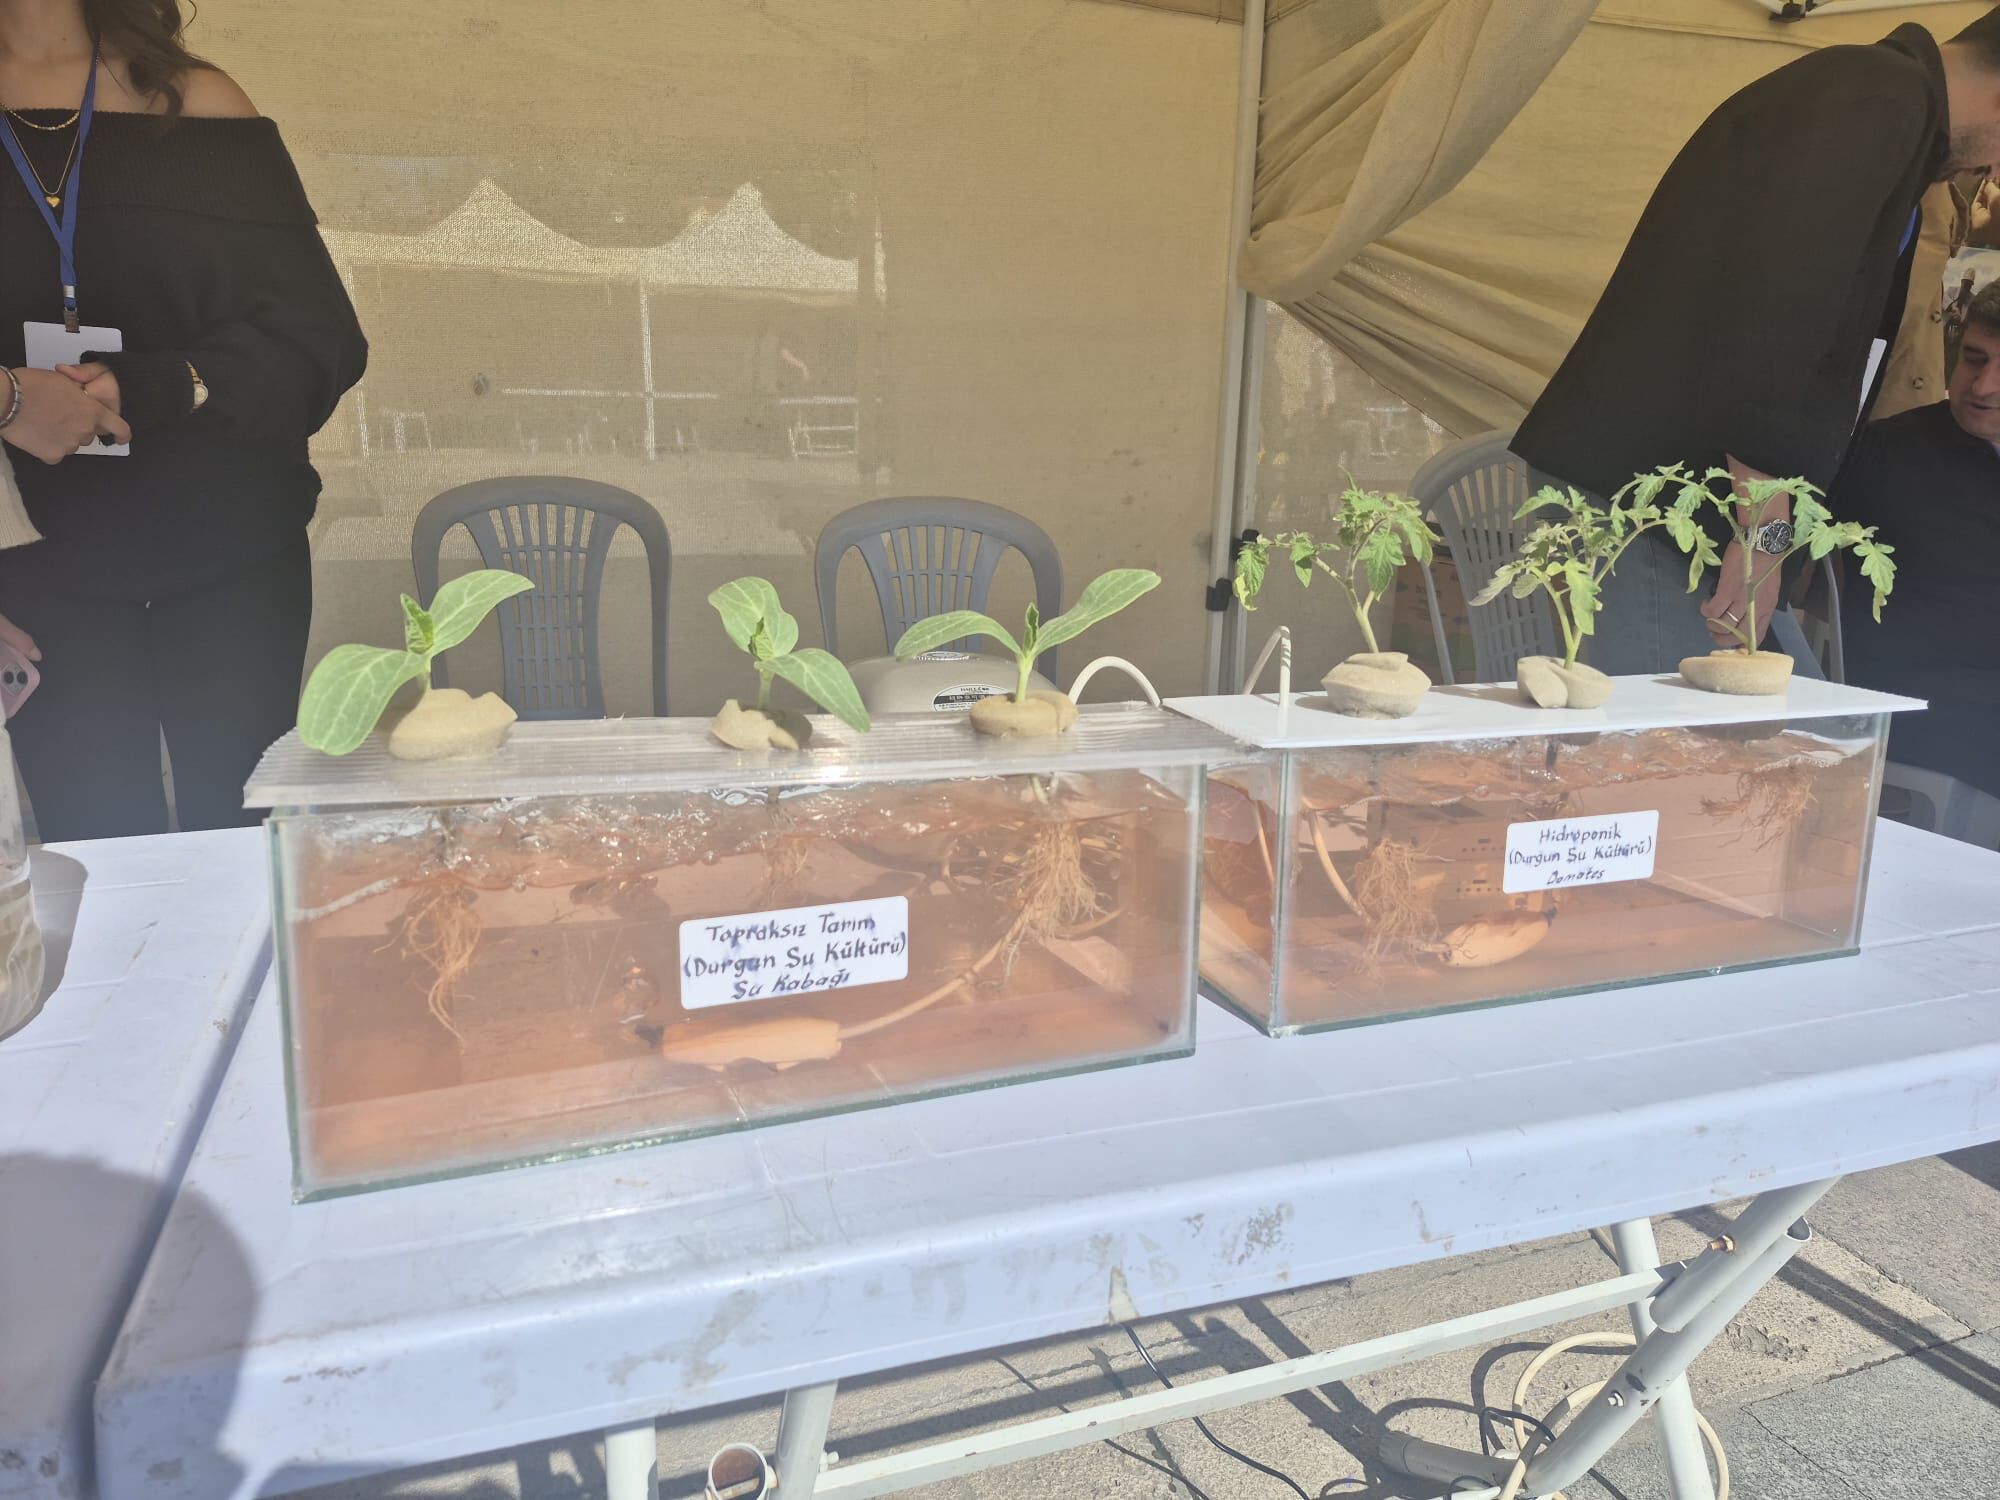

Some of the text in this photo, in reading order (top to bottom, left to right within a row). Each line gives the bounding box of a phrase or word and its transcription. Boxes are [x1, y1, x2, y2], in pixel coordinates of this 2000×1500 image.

[1566, 846, 1587, 865] Su
[785, 947, 814, 969] Su
[731, 980, 764, 1000] Su
